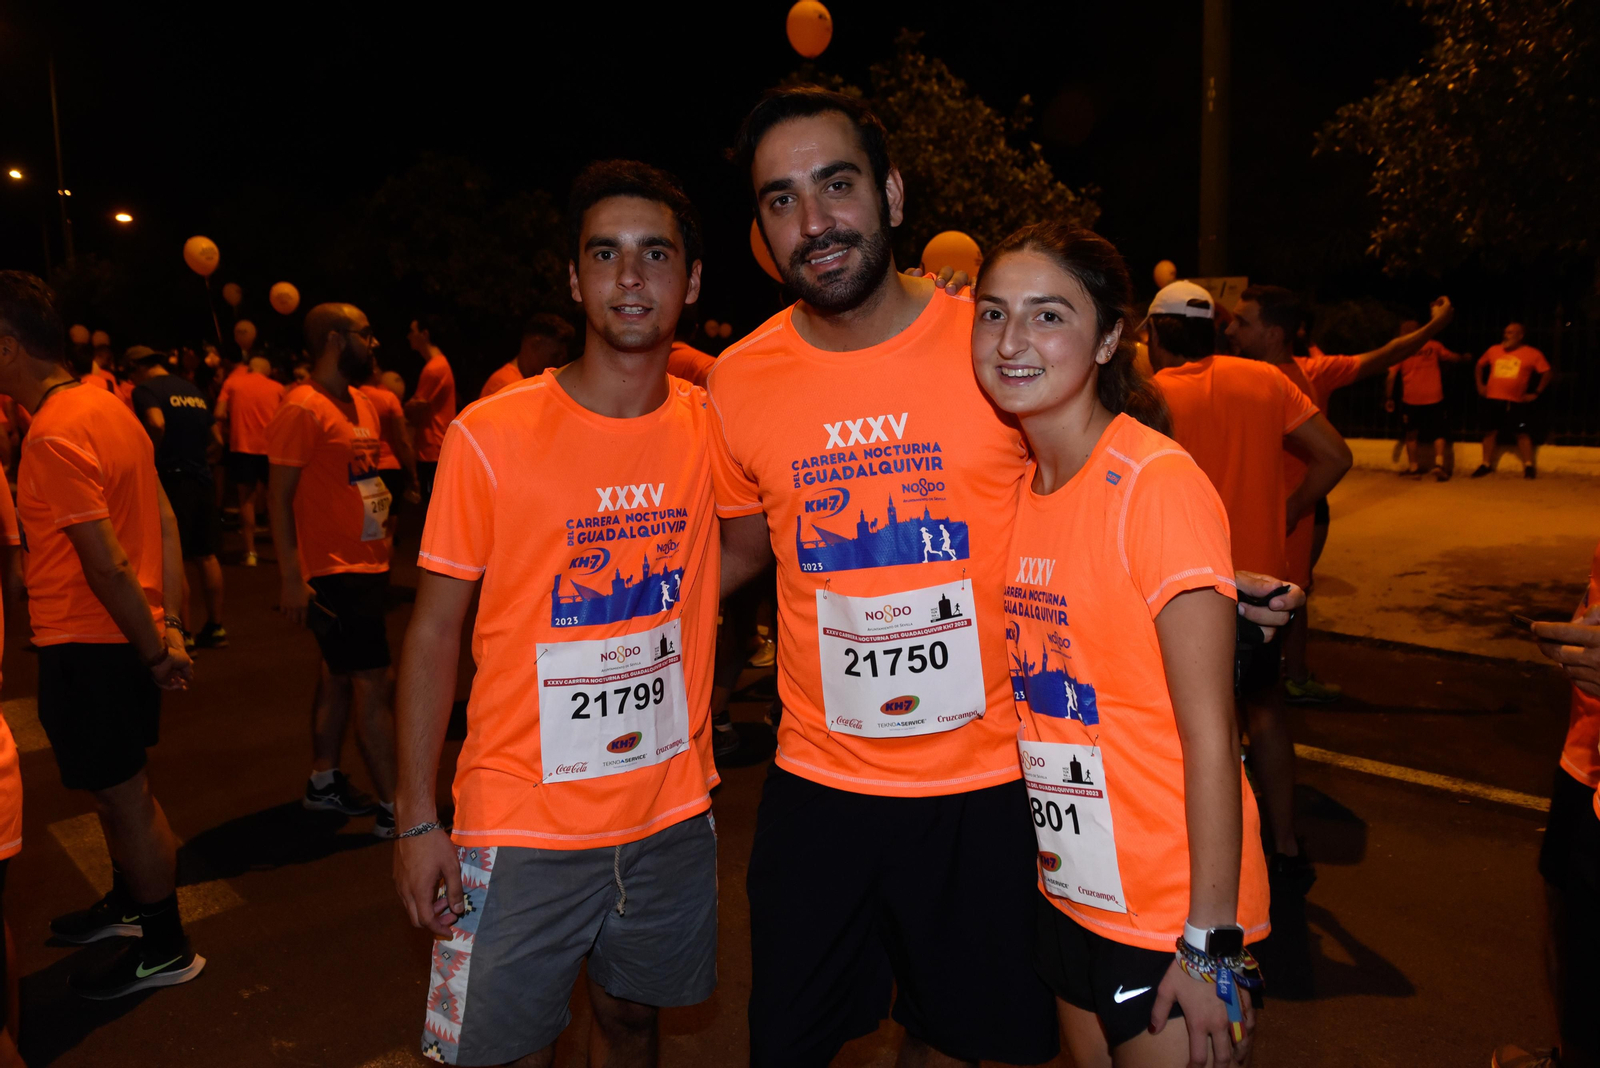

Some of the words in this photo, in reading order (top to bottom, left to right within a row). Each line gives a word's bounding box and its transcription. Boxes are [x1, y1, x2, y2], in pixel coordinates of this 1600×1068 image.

[823, 412, 909, 450] XXXV
[792, 451, 858, 471] CARRERA
[864, 442, 942, 459] NOCTURNA
[803, 456, 943, 486] GUADALQUIVIR
[596, 483, 665, 512] XXXV
[566, 515, 620, 529] CARRERA
[626, 508, 688, 523] NOCTURNA
[578, 520, 687, 544] GUADALQUIVIR
[802, 563, 823, 571] 2023
[1015, 556, 1056, 587] XXXV
[1029, 590, 1067, 607] NOCTURNA
[555, 617, 579, 626] 2023
[1004, 600, 1069, 626] GUADALQUIVIR
[839, 632, 857, 640] CARRERA
[901, 627, 942, 638] GUADALQUIVIR
[630, 663, 662, 676] GUADALQUIVIR
[844, 641, 949, 677] 21750
[571, 677, 664, 720] 21799
[938, 710, 978, 723] Cruzcampo
[656, 739, 683, 756] Cruzcampo
[1039, 784, 1074, 794] GUADALQUIVIR
[1030, 797, 1080, 835] 801
[1078, 886, 1115, 902] Cruzcampo
